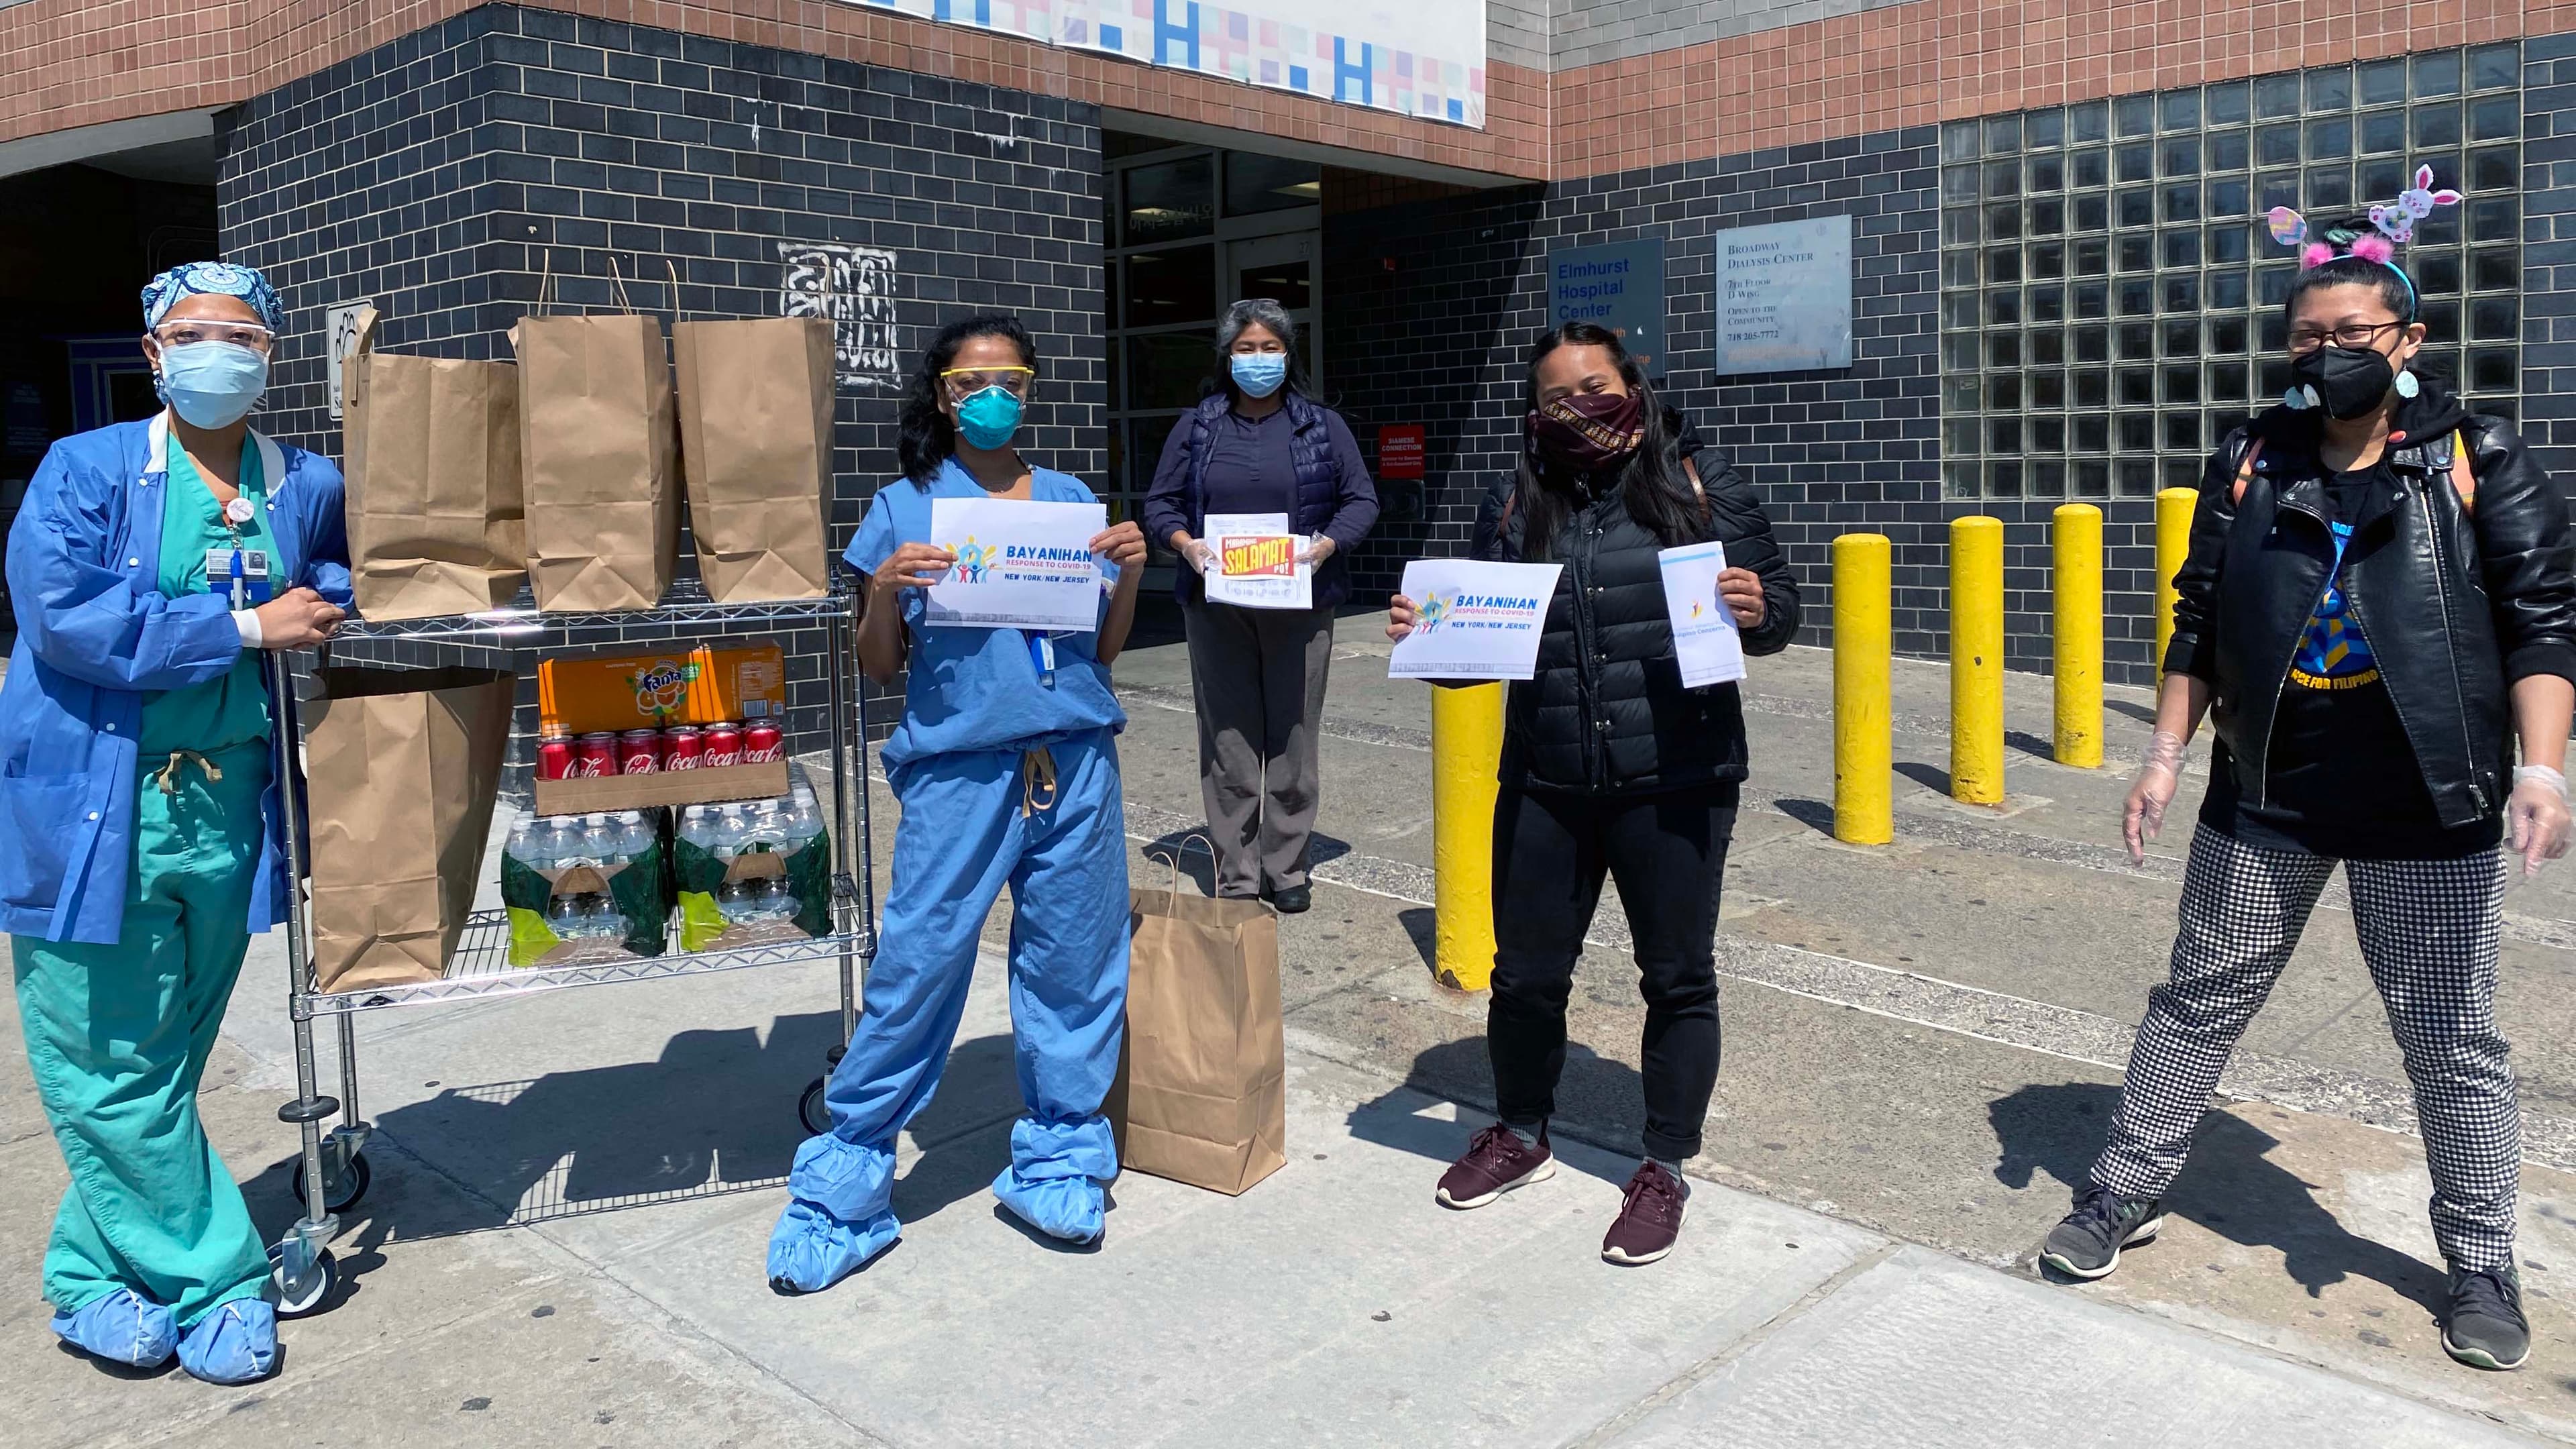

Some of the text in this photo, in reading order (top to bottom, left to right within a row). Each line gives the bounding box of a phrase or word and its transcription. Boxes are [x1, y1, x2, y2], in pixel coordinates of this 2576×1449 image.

[1558, 258, 1629, 279] Elmhurst
[1728, 253, 1814, 269] DIALYSIS CENTER
[1558, 279, 1623, 301] Hospital
[1729, 290, 1735, 299] D
[1558, 303, 1612, 319] Center
[1728, 307, 1748, 315] OPEN
[1728, 316, 1775, 325] COMMUNITY
[1744, 330, 1779, 340] 205-7772
[1007, 545, 1092, 562] BAYANIHAN
[1274, 563, 1289, 574] PO!
[1456, 595, 1538, 609] BAYANIHAN
[643, 669, 682, 693] Fanta
